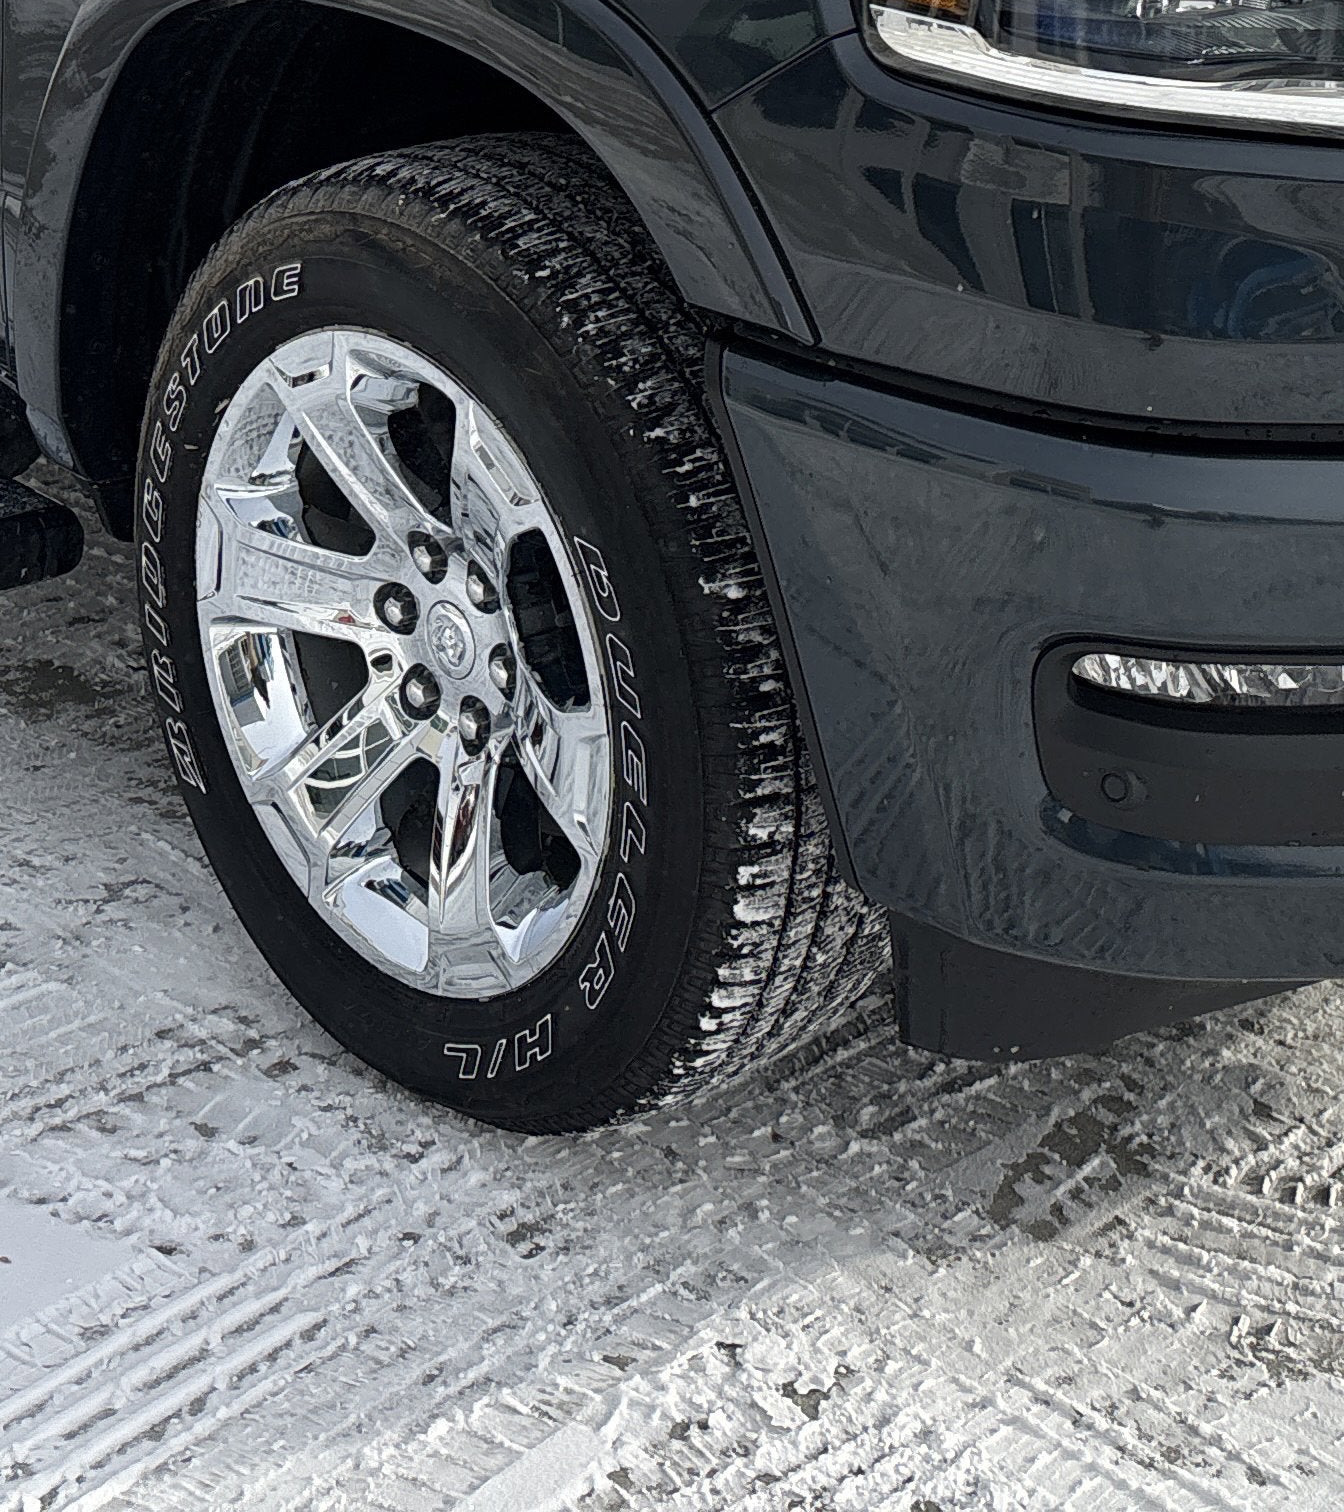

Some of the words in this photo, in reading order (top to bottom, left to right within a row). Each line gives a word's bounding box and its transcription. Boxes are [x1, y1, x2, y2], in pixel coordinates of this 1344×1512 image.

[141, 263, 301, 795] BRIDGESTONE
[573, 535, 647, 1010] DUELER
[443, 1013, 552, 1079] H/L
